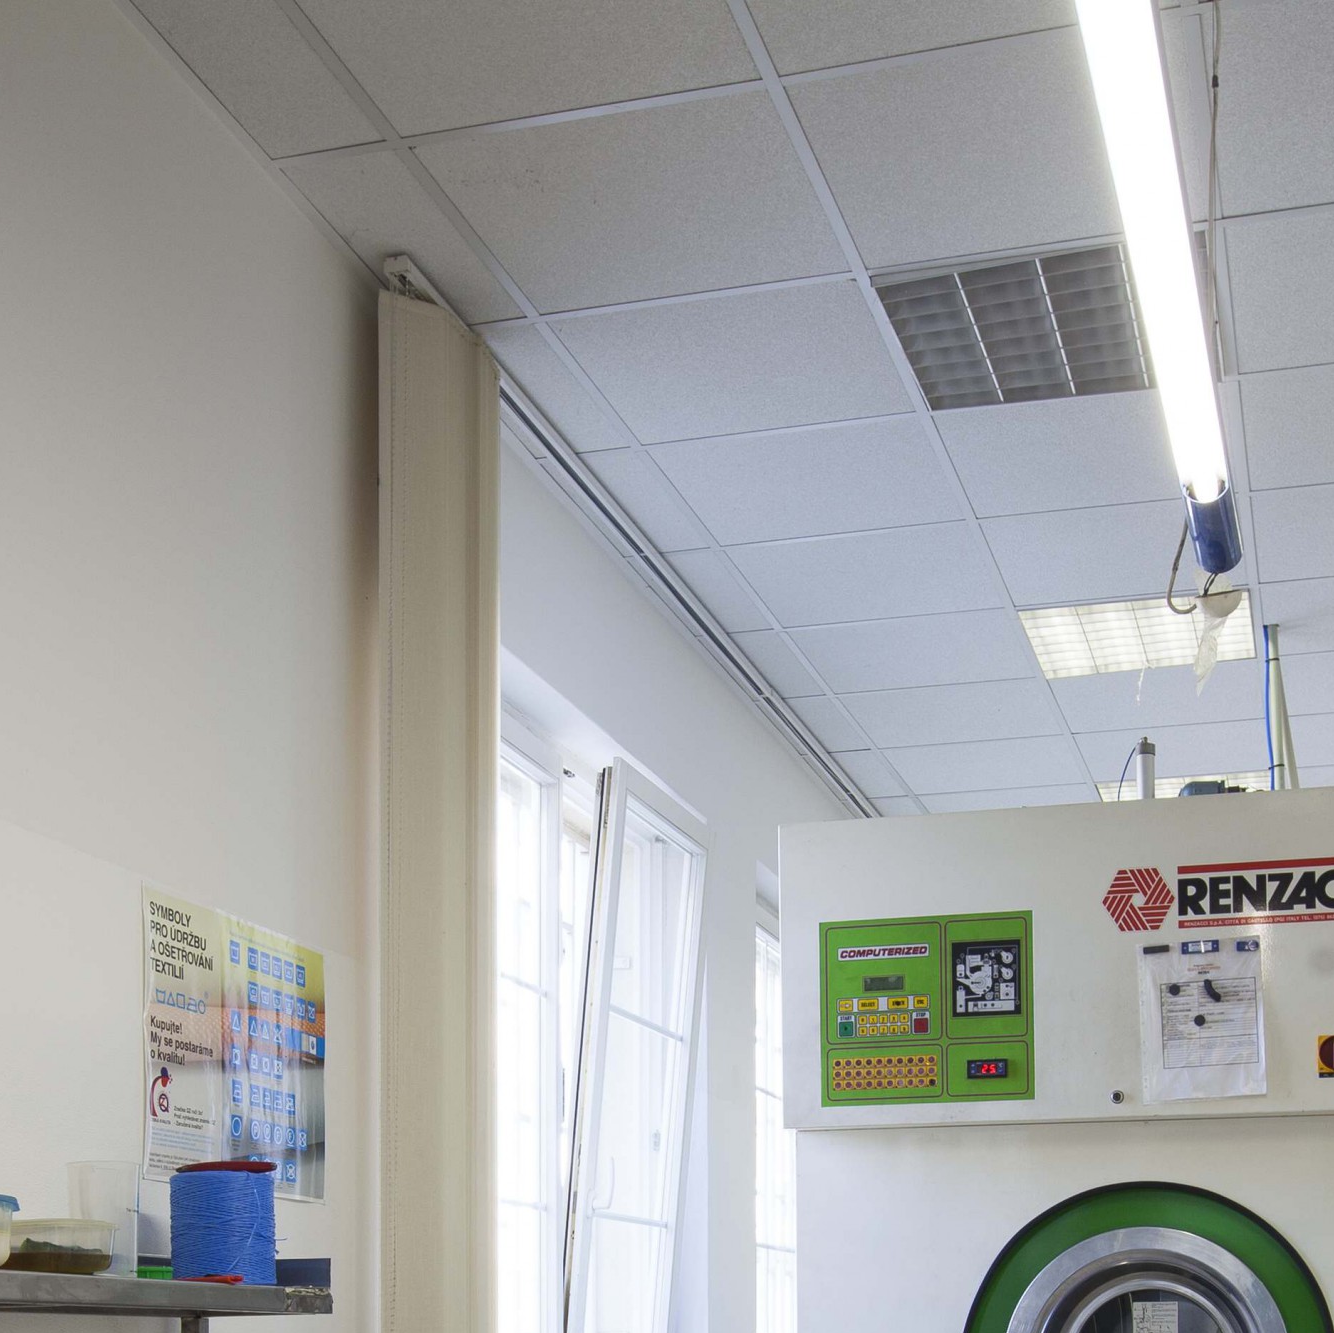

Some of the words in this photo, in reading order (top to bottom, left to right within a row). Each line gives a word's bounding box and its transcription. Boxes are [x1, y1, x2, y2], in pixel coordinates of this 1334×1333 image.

[150, 901, 191, 928] SYMBOLY
[150, 920, 167, 938] PRO
[170, 925, 207, 951] ÚDRŽBU
[150, 939, 156, 953] A
[158, 941, 213, 972] OŠETŘOVÁNÍ
[840, 946, 928, 959] COMPUTERIZED
[150, 957, 184, 980] TEXTILIÍ
[150, 1015, 182, 1035] Kupujte!
[150, 1049, 156, 1059] o
[157, 1048, 185, 1066] kvalitu!
[151, 1031, 162, 1047] My
[164, 1037, 173, 1047] se
[175, 1040, 213, 1058] postaráme
